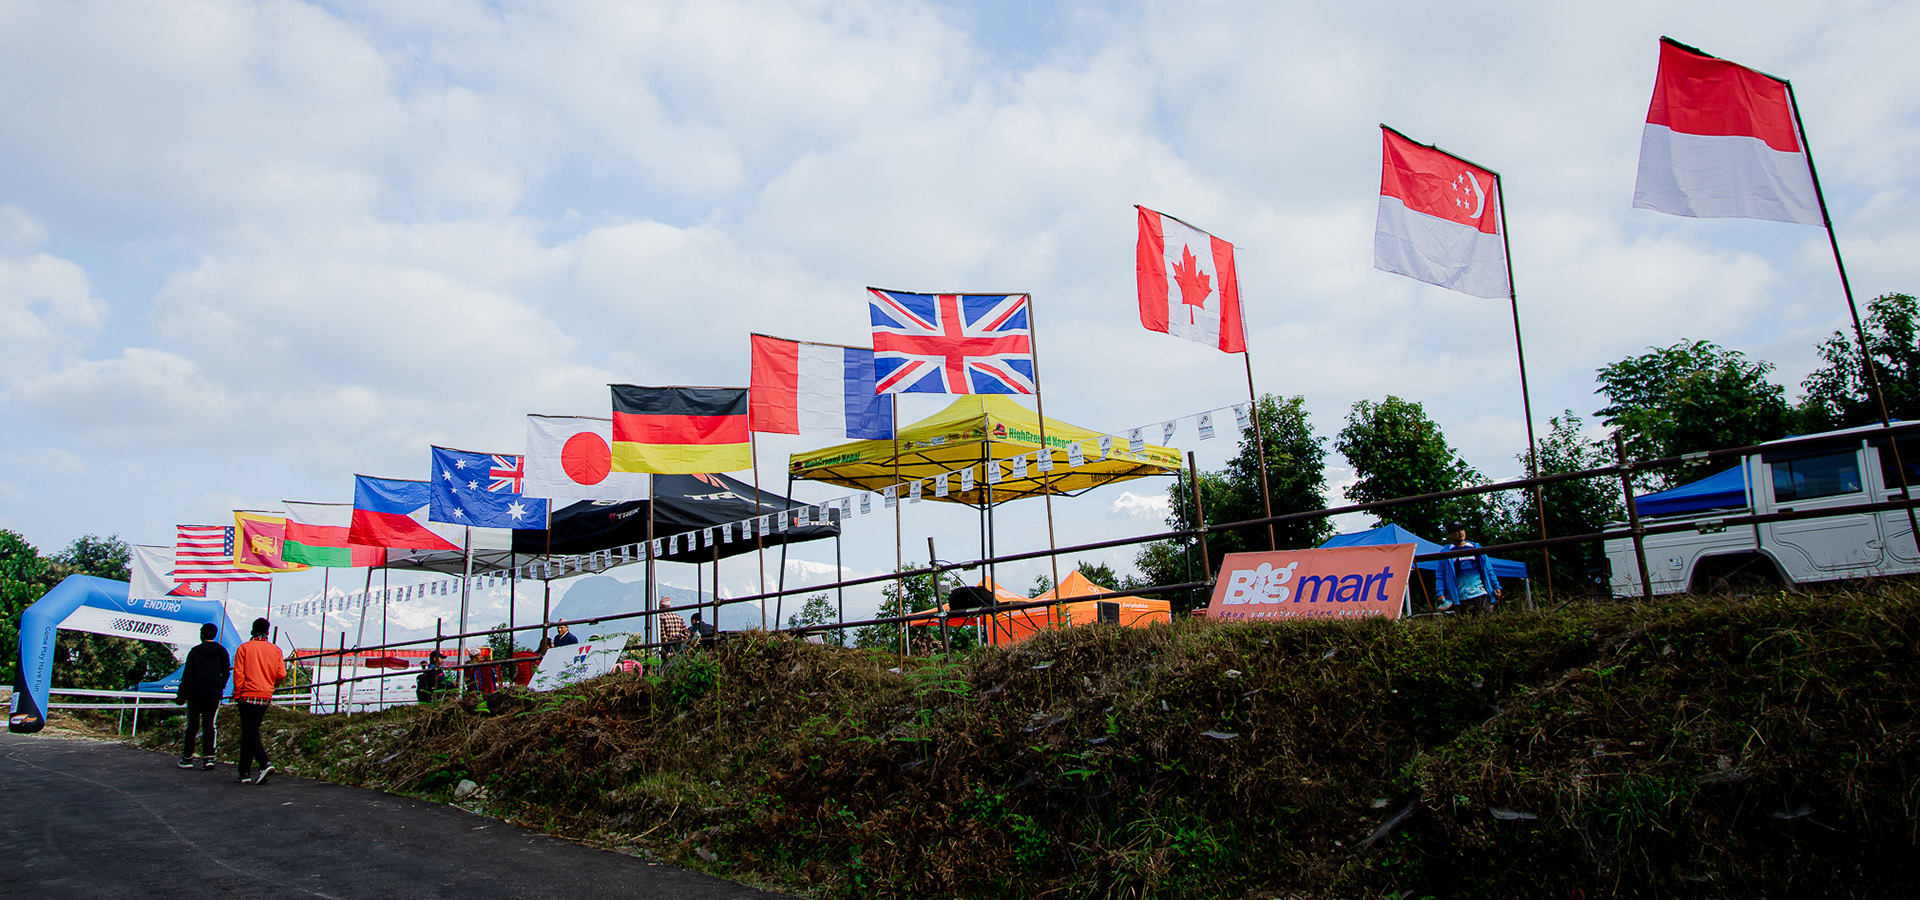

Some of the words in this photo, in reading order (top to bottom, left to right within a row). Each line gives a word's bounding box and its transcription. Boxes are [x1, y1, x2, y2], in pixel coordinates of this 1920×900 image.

[616, 507, 641, 520] TREK
[1222, 562, 1298, 605] Big
[1294, 566, 1394, 603] mart
[143, 599, 181, 613] ENDURO
[125, 620, 158, 635] START
[43, 626, 51, 646] Come
[39, 646, 48, 660] Play
[37, 661, 46, 678] Have
[34, 679, 42, 692] Fun
